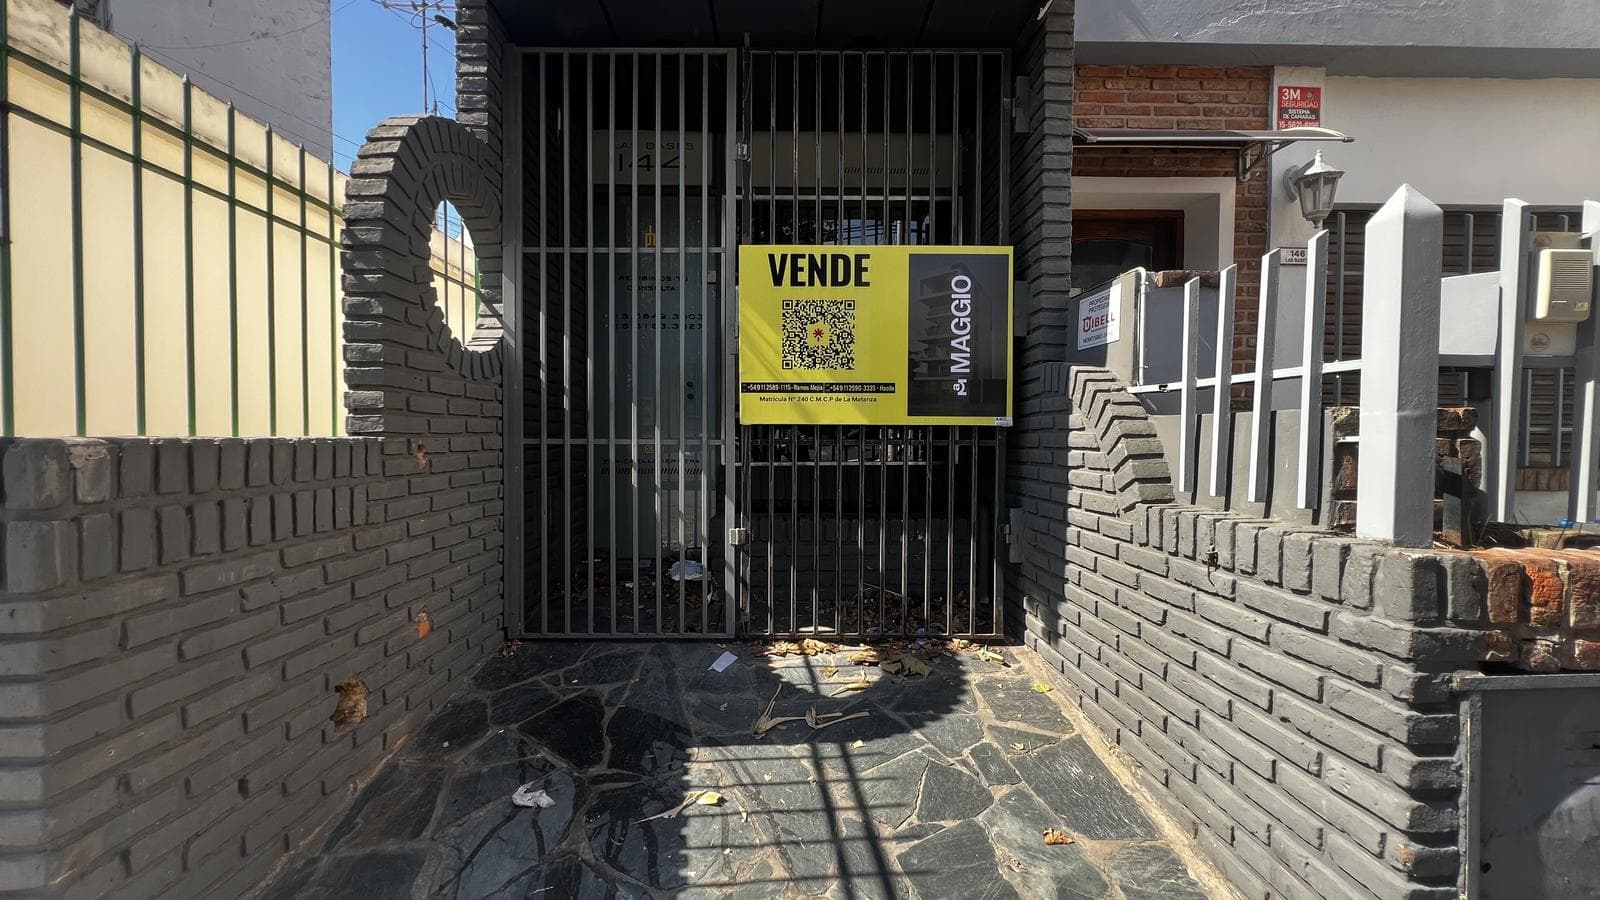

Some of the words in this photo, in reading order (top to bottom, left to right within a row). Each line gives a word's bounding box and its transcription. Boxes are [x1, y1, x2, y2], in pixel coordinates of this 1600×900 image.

[1281, 88, 1301, 101] 3M
[1281, 100, 1319, 108] SEGURIDAD
[1291, 249, 1306, 258] 146
[768, 253, 871, 288] VENDE
[950, 275, 972, 374] MAGGIO
[1083, 312, 1116, 333] DIBELL
